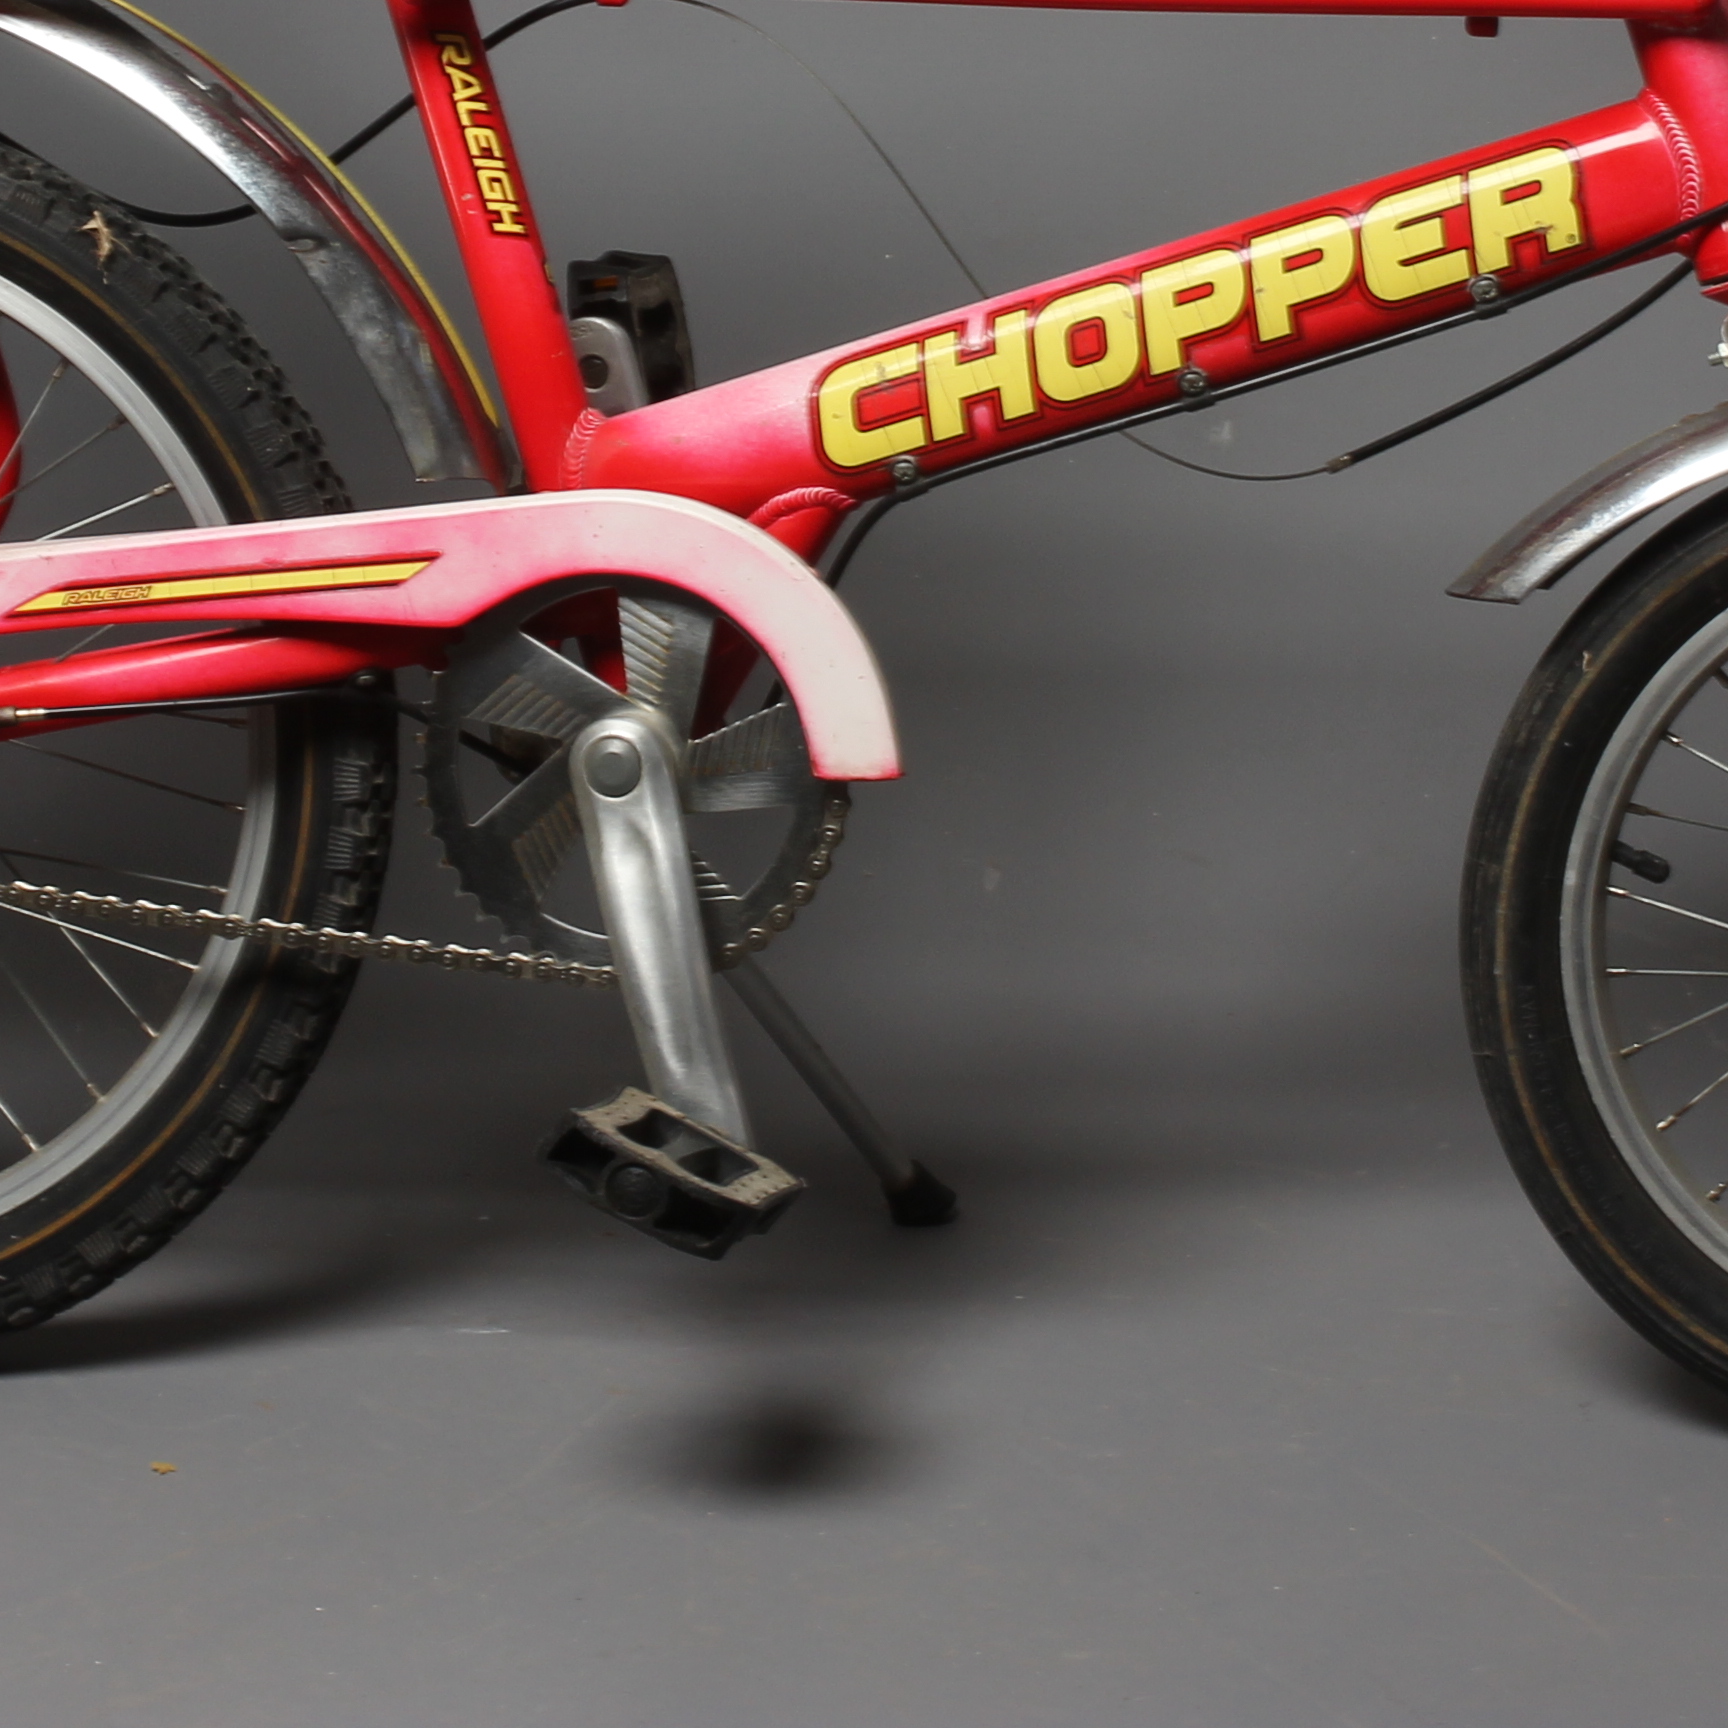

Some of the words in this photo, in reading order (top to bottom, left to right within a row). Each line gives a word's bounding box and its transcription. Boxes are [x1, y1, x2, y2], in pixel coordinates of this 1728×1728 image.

[433, 32, 529, 235] RALEIGH
[818, 144, 1585, 469] CHOPPER
[61, 585, 153, 606] RALEIGH
